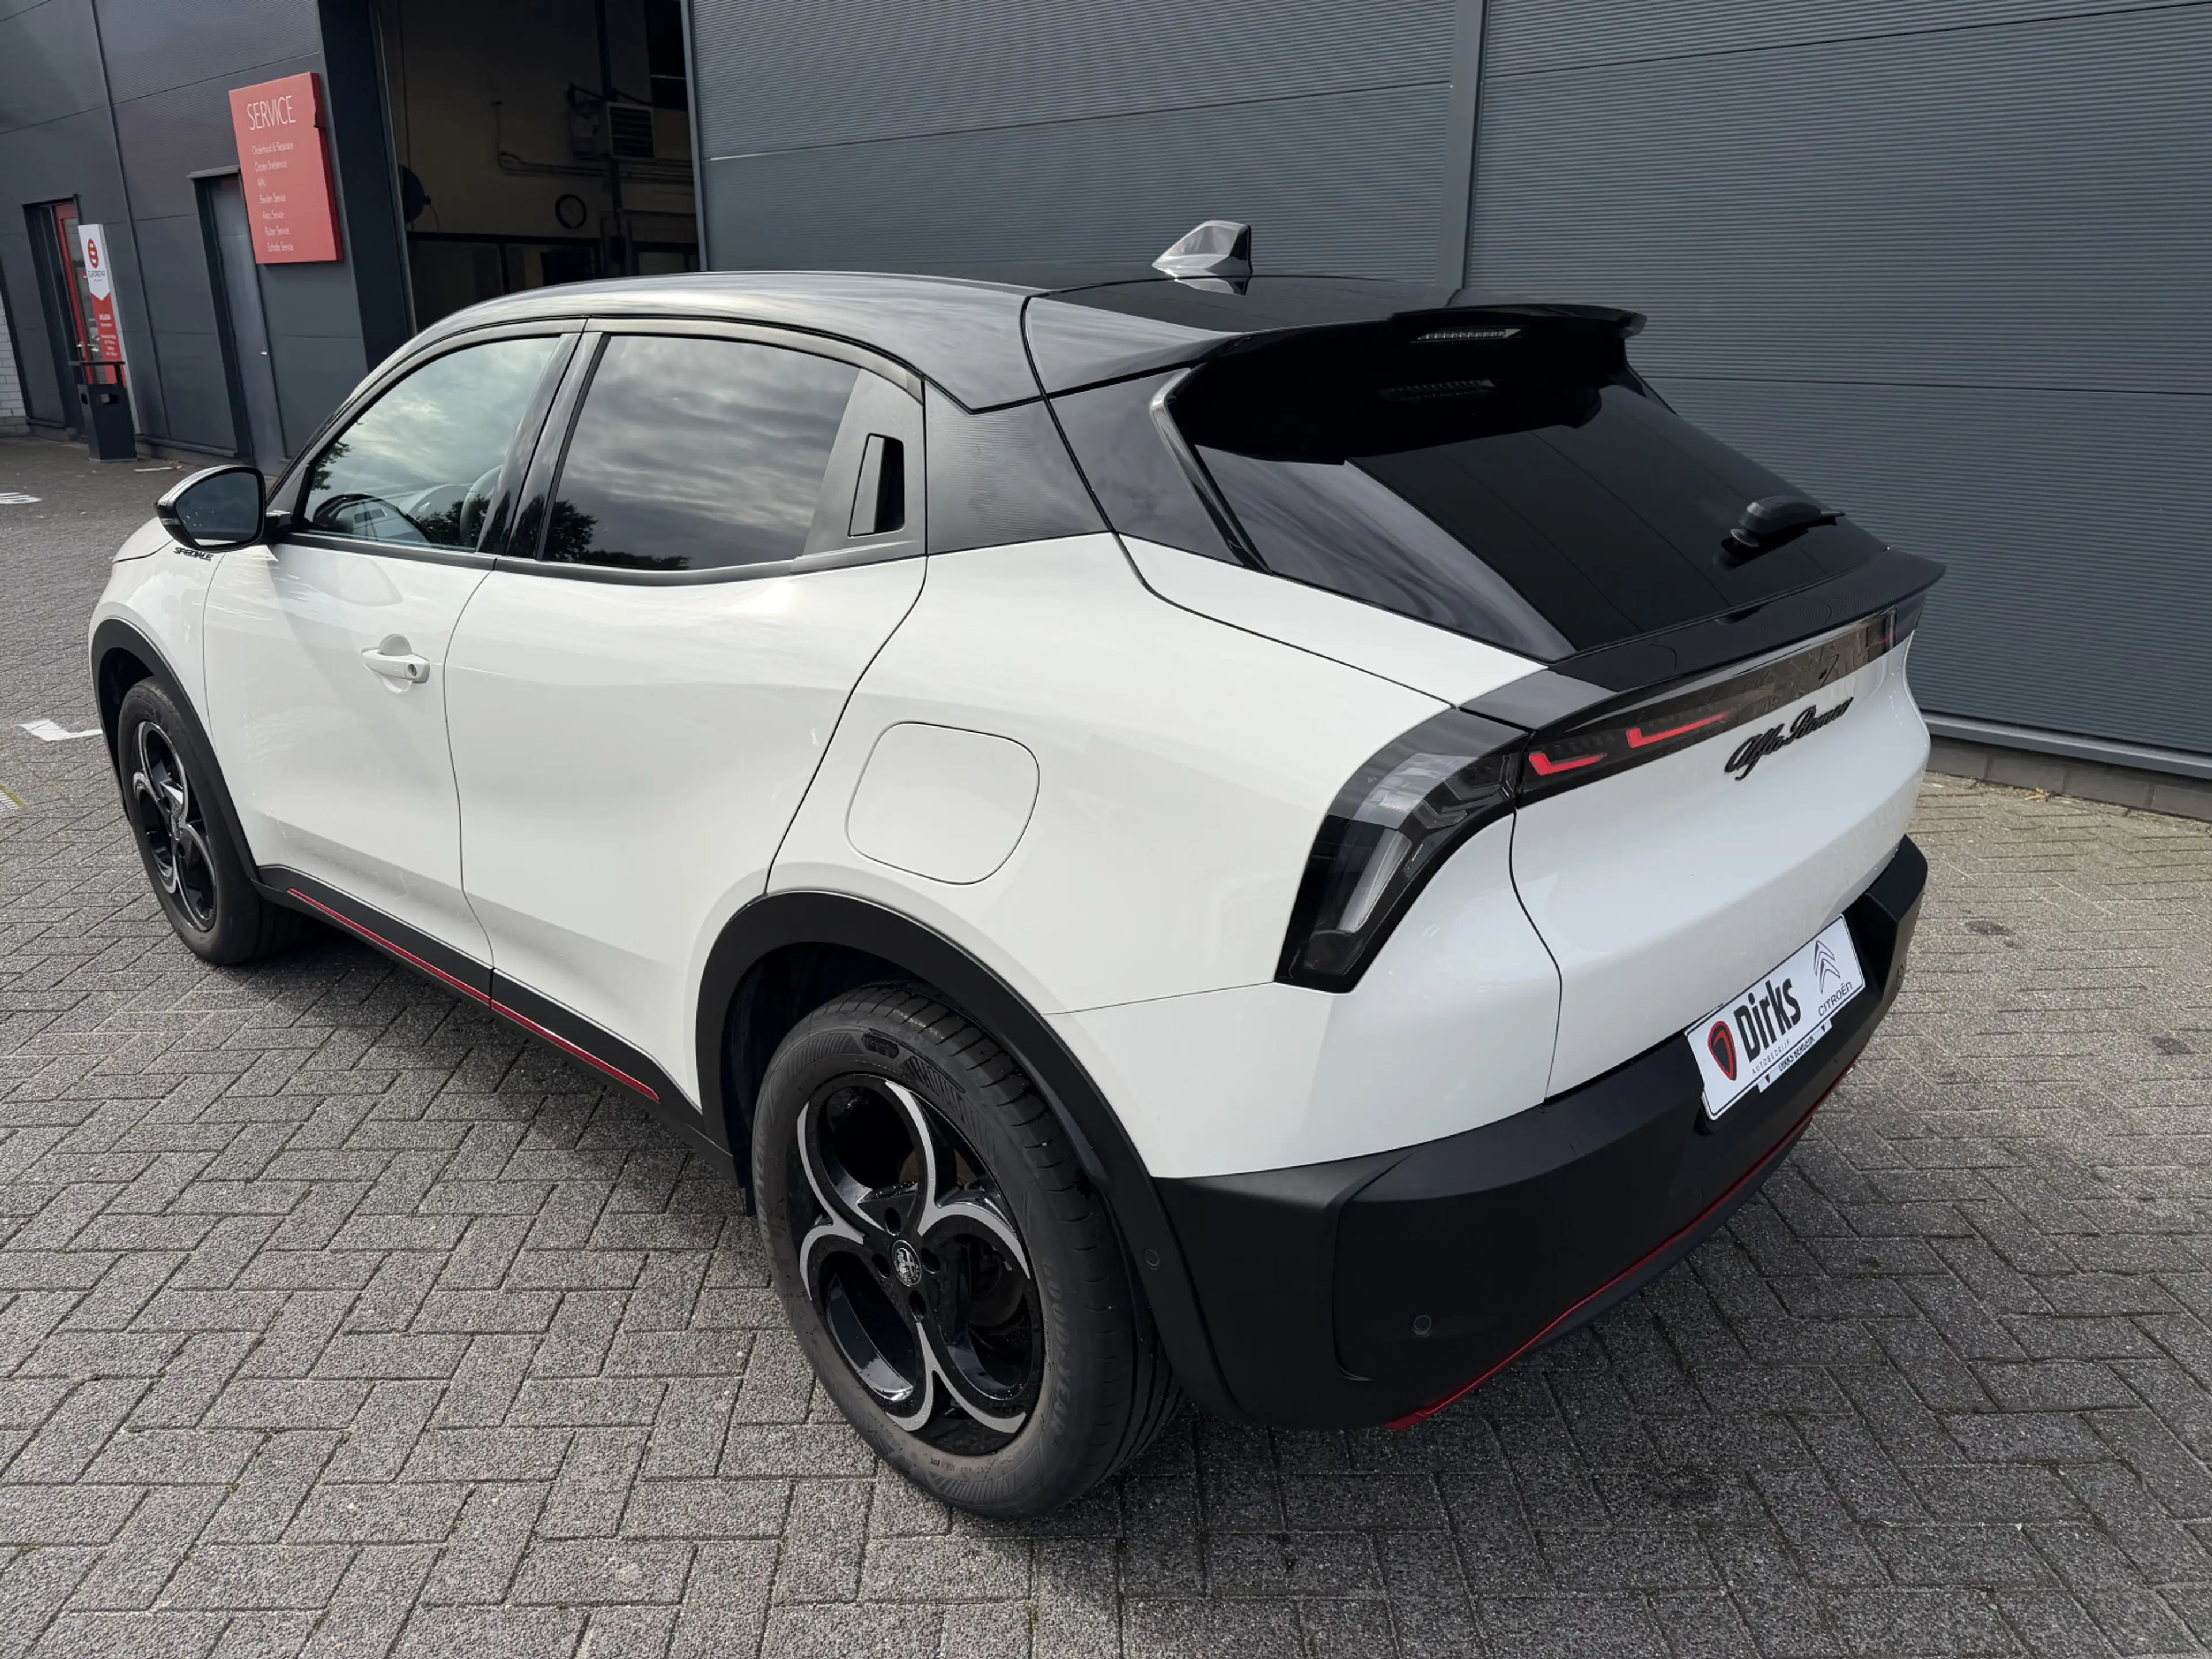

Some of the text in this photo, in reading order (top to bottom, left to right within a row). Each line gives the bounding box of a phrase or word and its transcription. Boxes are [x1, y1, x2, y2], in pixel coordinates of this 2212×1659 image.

[247, 94, 296, 130] SERVICE
[1724, 723, 1786, 781] Alfa
[1733, 978, 1801, 1063] Dirks
